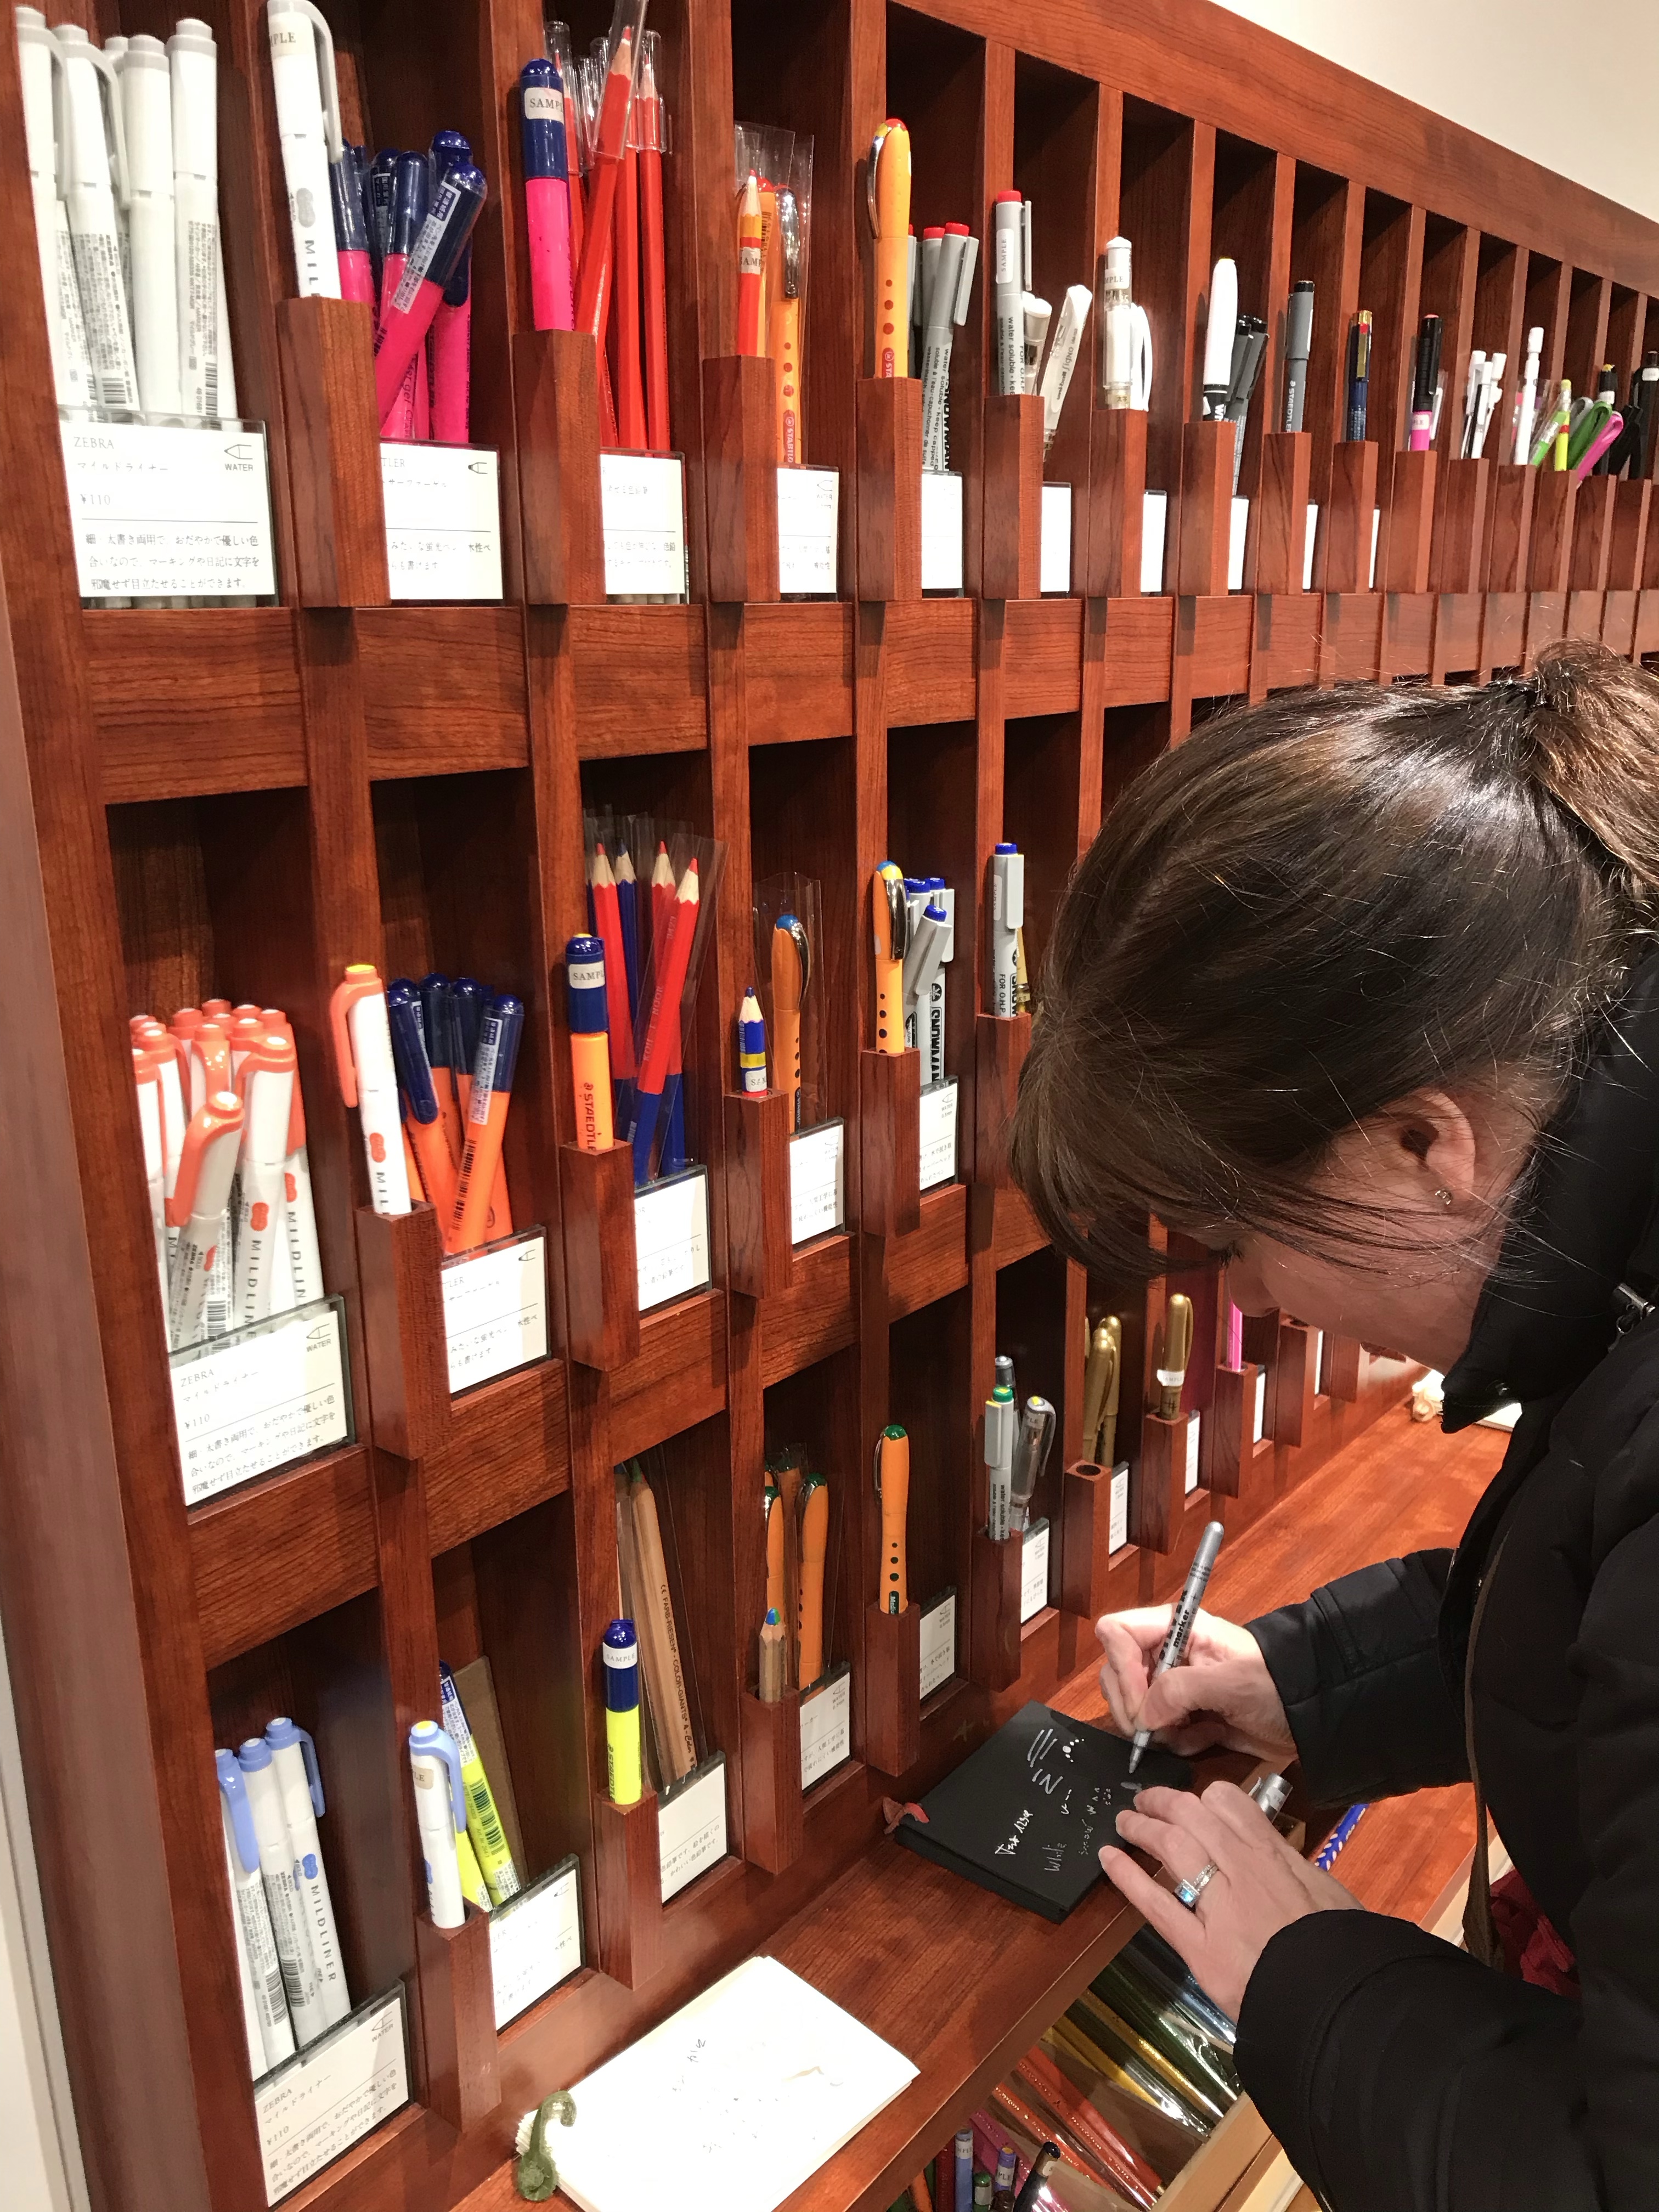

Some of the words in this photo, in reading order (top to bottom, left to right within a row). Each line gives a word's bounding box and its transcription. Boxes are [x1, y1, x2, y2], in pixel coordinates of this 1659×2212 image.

[270, 32, 297, 47] PLE
[304, 239, 321, 296] MIL
[885, 363, 894, 379] STA
[937, 375, 945, 405] soluble
[74, 437, 115, 449] ZEBRA
[930, 435, 938, 467] capped
[225, 464, 253, 472] WATER
[80, 494, 111, 505] ¥110
[377, 1171, 389, 1214] MIL
[306, 1339, 332, 1352] WATER
[180, 1369, 215, 1387] ZEBRA
[184, 1413, 211, 1430] ¥110
[1172, 1609, 1190, 1649] marker
[606, 1652, 635, 1663] SAMPLE
[412, 1771, 425, 1782] LE
[310, 1884, 336, 1982] MILDLINER
[371, 2023, 394, 2043] WATER
[263, 2088, 293, 2114] ZEBRA
[267, 2125, 290, 2146] ¥110
